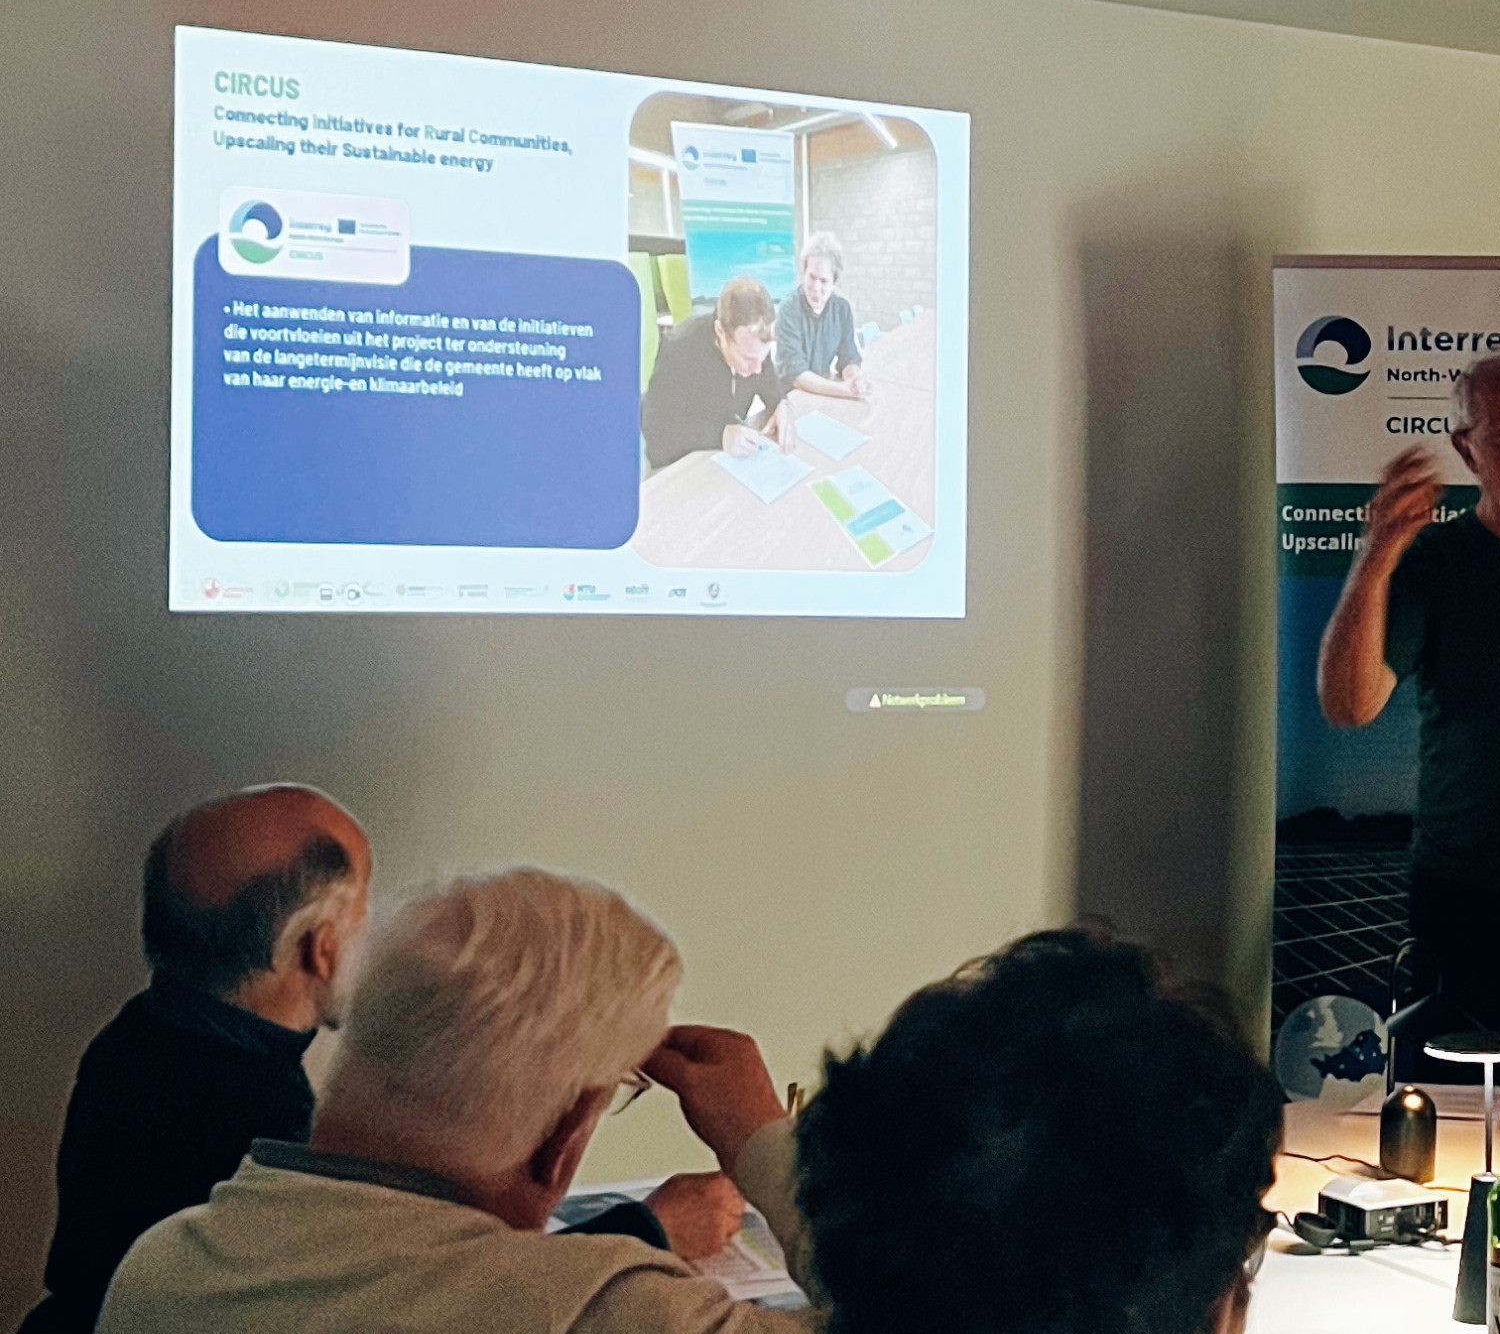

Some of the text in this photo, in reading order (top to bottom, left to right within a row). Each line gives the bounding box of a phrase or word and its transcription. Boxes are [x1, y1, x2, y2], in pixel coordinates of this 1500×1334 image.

[214, 71, 300, 99] CIRCUS
[214, 105, 308, 130] Connecting
[398, 122, 420, 138] for
[424, 124, 465, 142] Rural
[213, 130, 493, 172] Upscaling their Sustainable energy
[233, 300, 594, 337] Het aanwenden van informatie en van de initiatieven
[223, 323, 567, 361] die voortvloeien uit het project ter ondersteuning
[223, 348, 602, 382] van de langetermijnvisie die de gemeente heeft op vlak
[223, 373, 250, 386] van
[252, 371, 285, 387] haar
[1387, 368, 1461, 382] North-W
[1386, 417, 1450, 434] CIRC
[1281, 503, 1371, 522] Connecti
